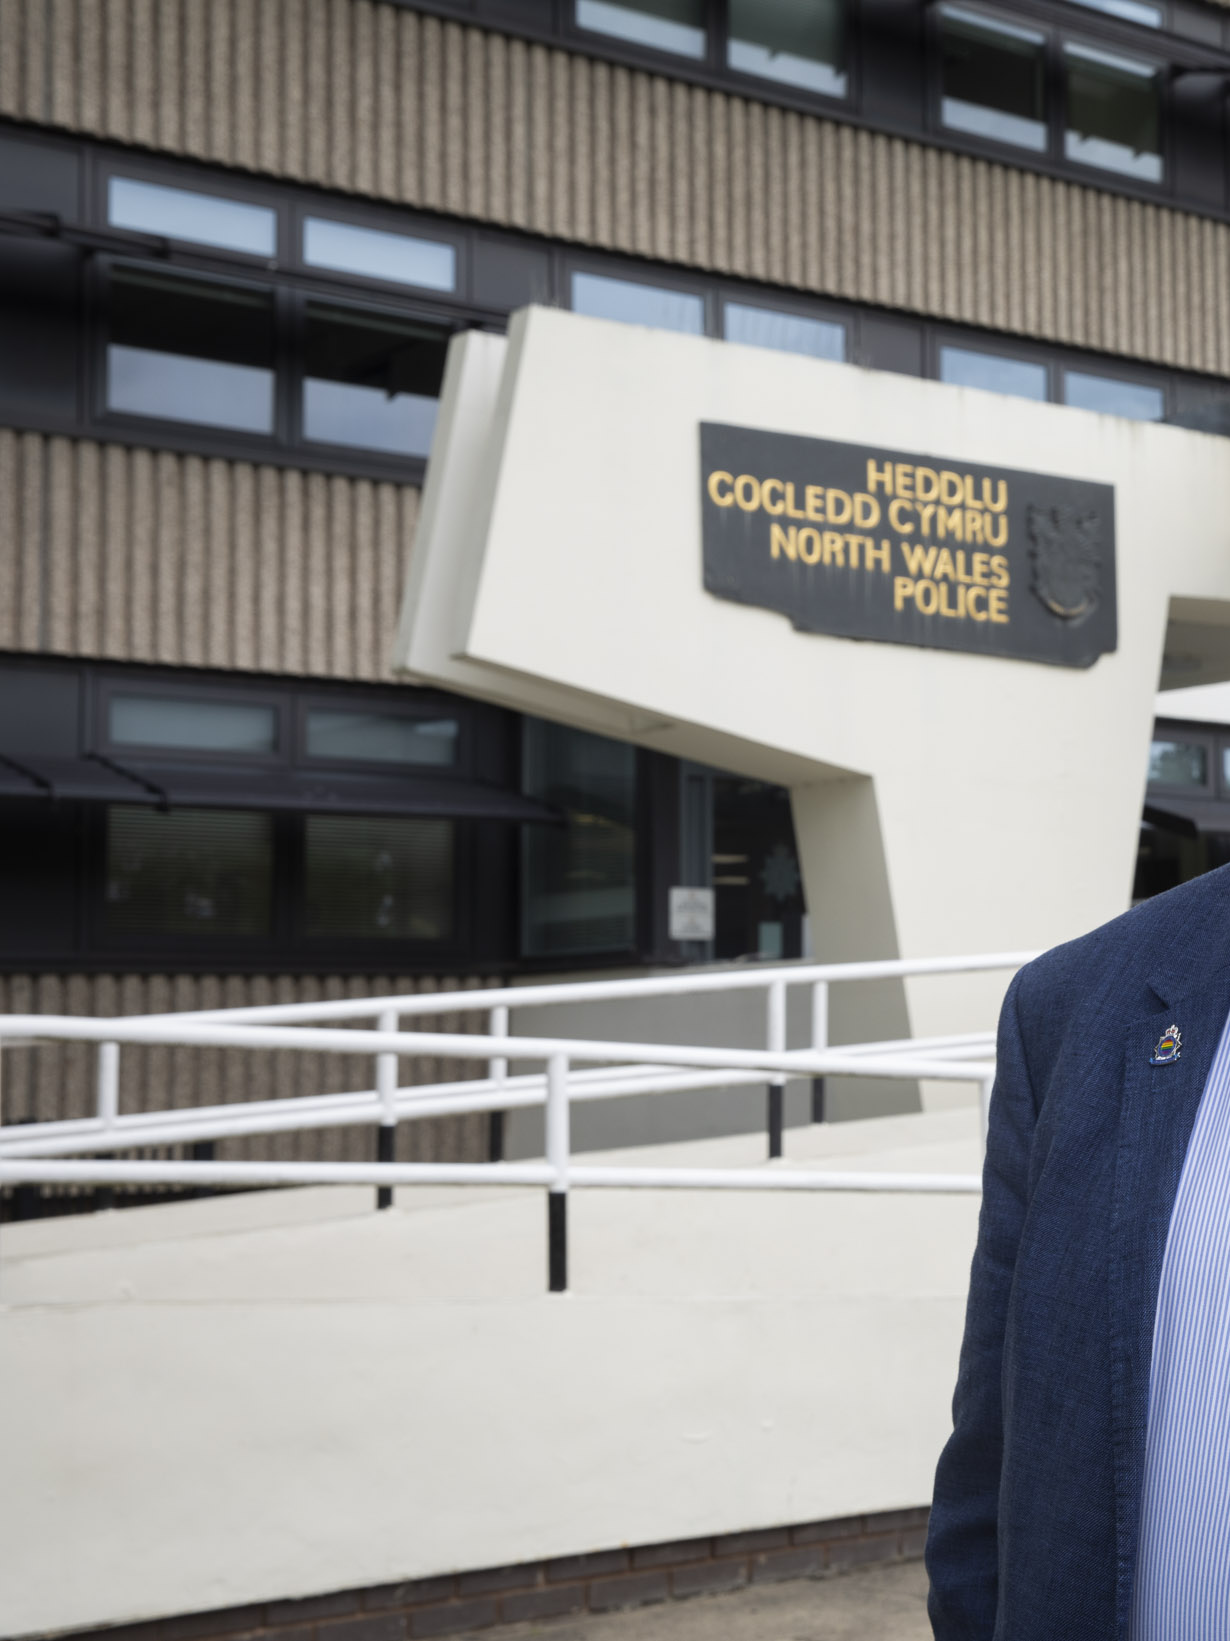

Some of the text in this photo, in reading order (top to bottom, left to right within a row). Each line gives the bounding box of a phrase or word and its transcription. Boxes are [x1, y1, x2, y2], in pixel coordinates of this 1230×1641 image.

[867, 459, 1008, 513] HEDDLU
[888, 498, 1008, 547] CYMRU
[770, 524, 1010, 588] NORTH WALES
[894, 576, 1010, 623] POLICE
